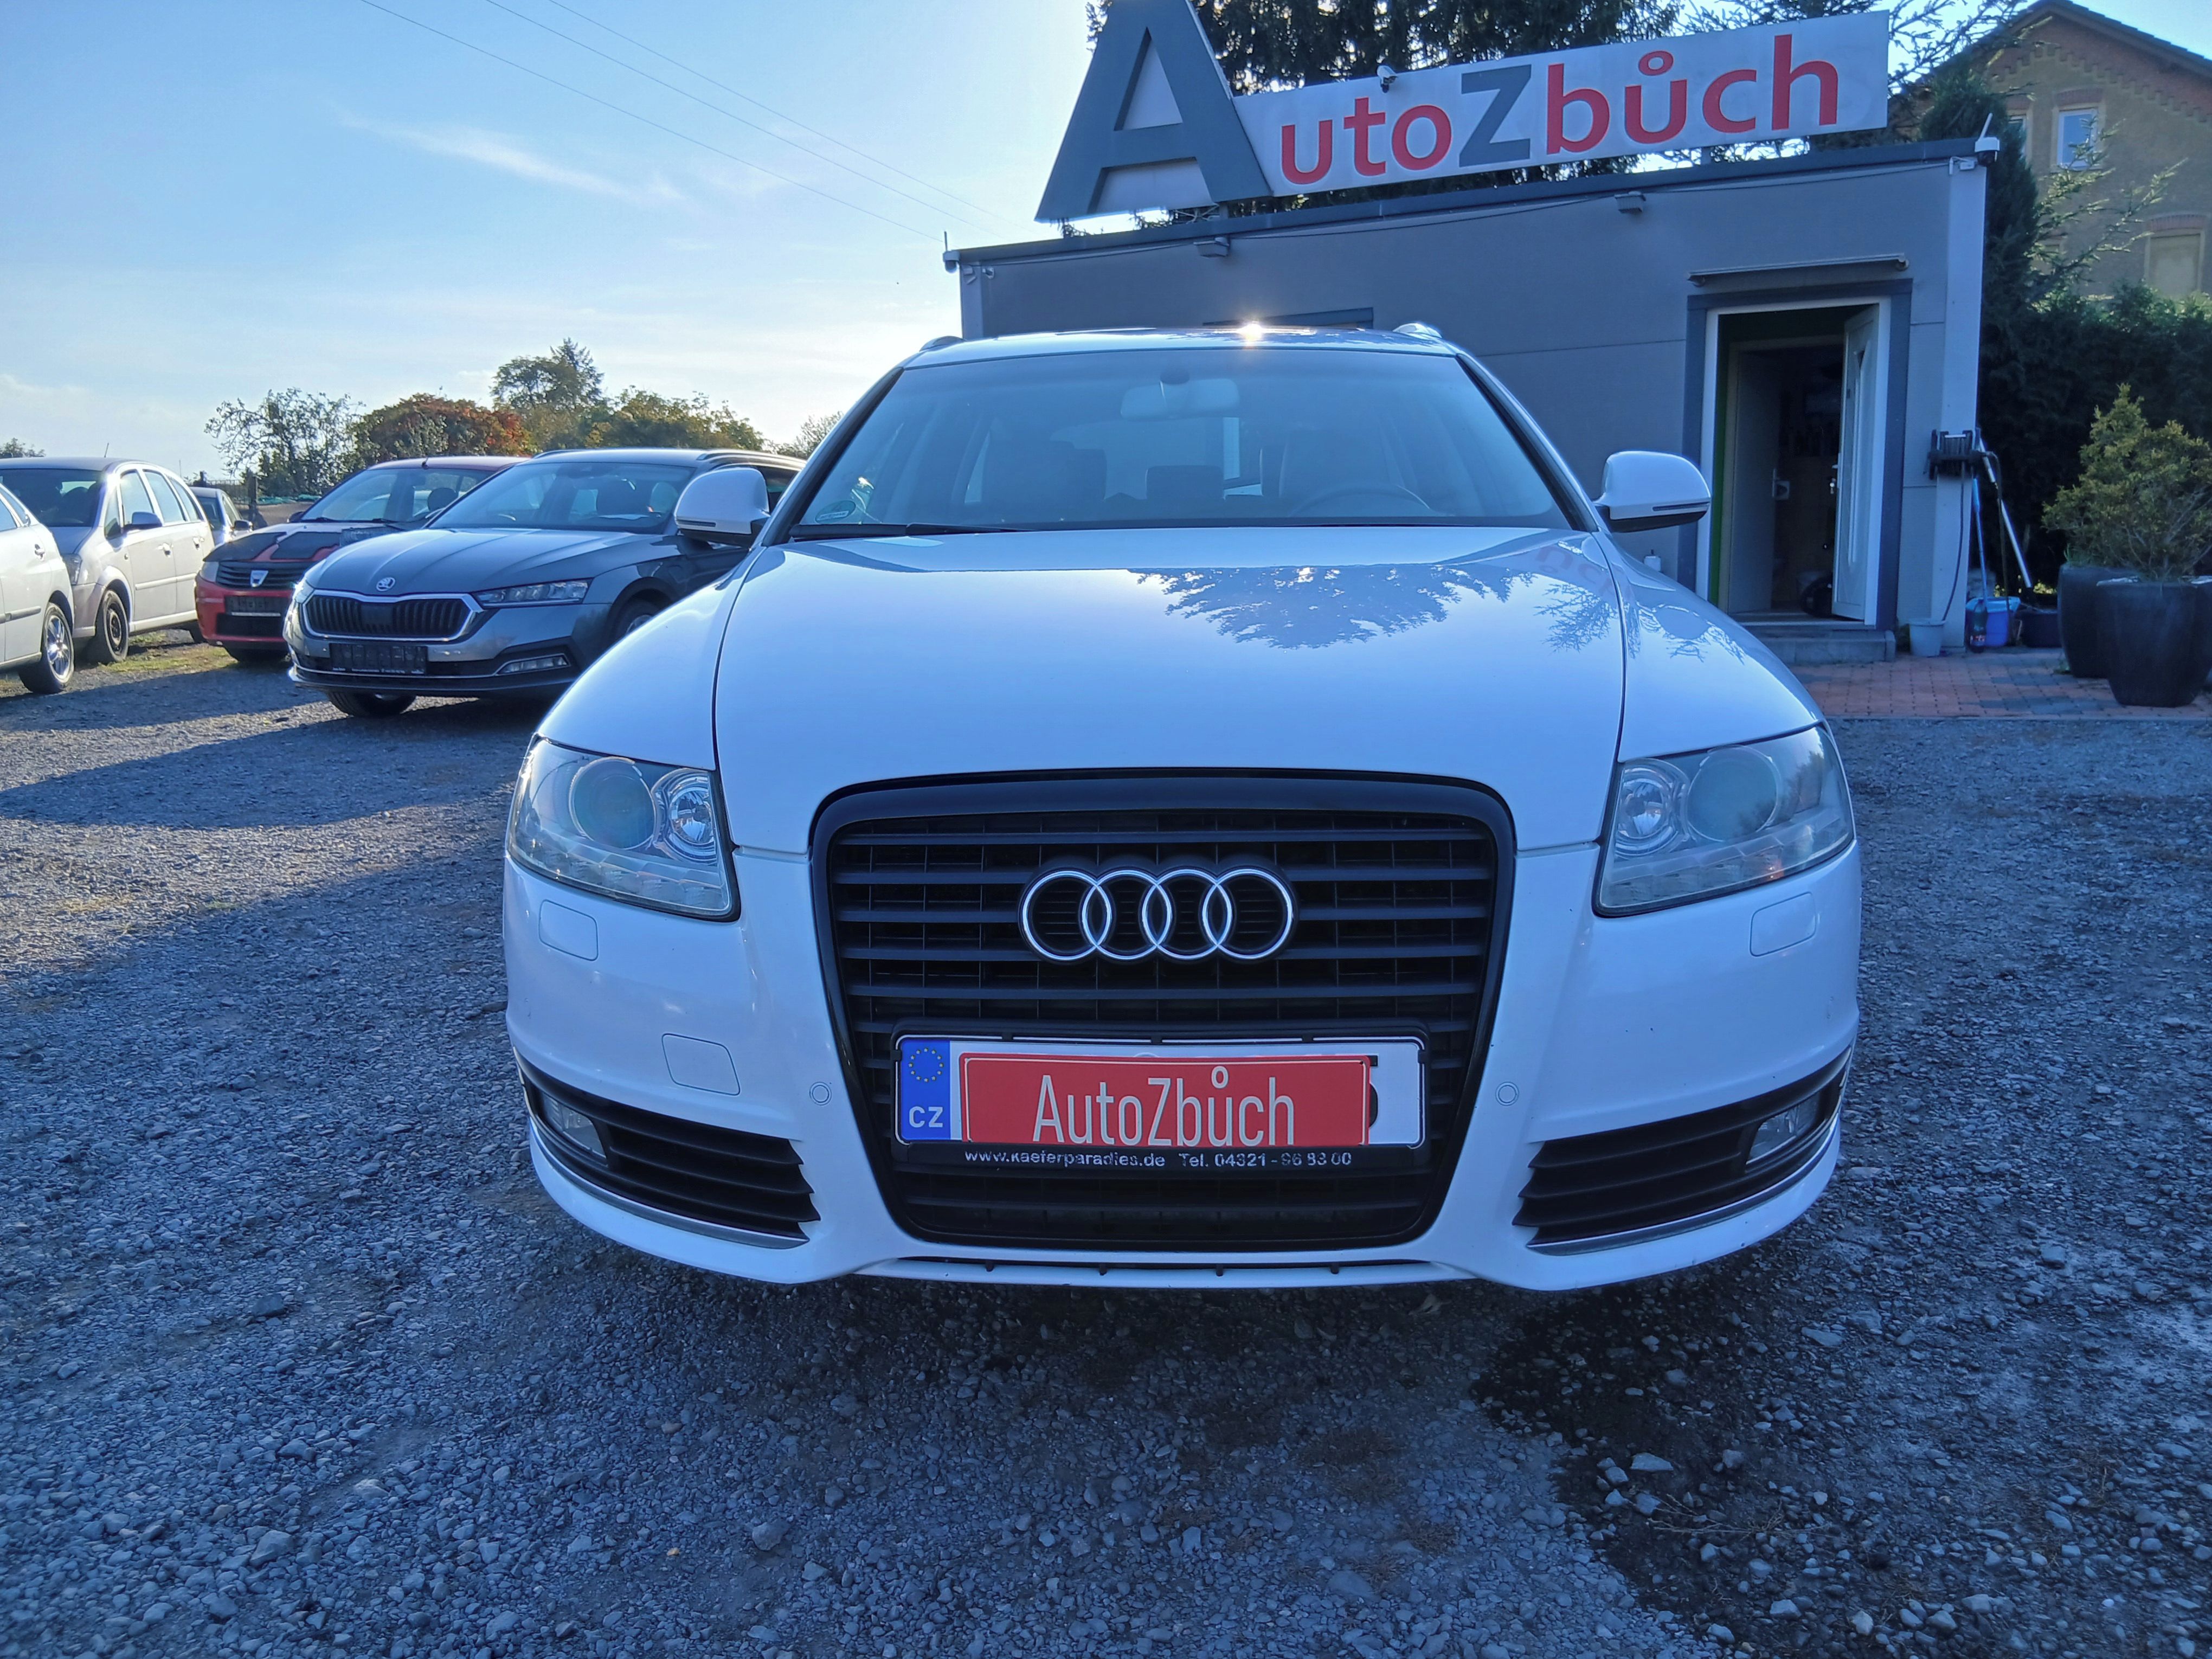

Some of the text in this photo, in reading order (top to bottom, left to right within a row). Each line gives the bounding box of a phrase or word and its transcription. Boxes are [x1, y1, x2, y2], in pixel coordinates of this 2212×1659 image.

[1034, 0, 1840, 221] AutoZbůch
[909, 1105, 943, 1128] CZ
[1032, 1066, 1295, 1147] AutoZbůch
[1178, 1153, 1208, 1167] Tel.
[1214, 1153, 1265, 1167] 04321
[1331, 1152, 1352, 1166] 00
